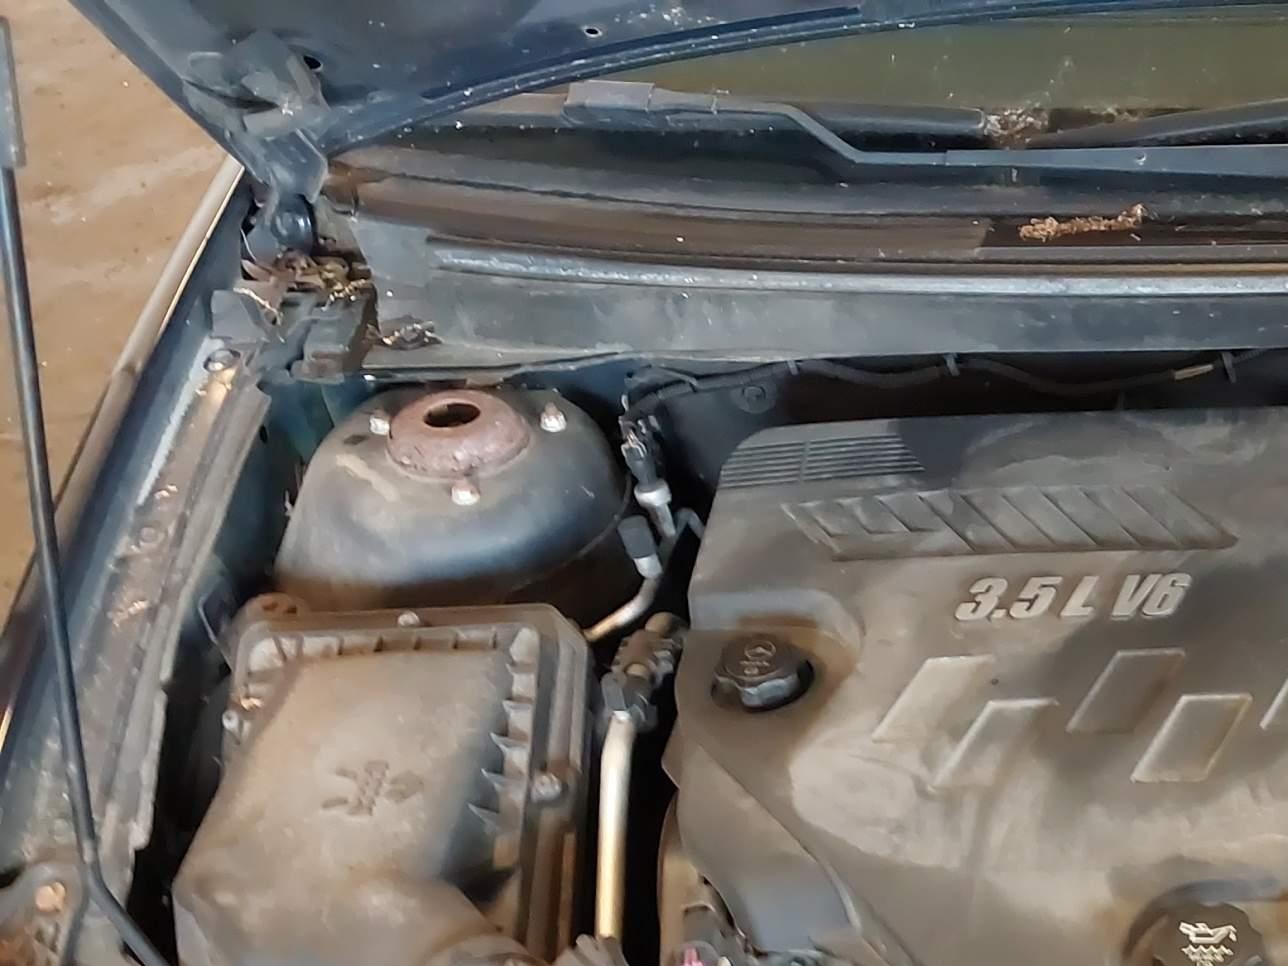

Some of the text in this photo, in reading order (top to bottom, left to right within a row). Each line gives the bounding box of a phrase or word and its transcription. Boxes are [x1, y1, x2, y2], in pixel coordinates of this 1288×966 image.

[955, 573, 1191, 621] 3.5 L V6
